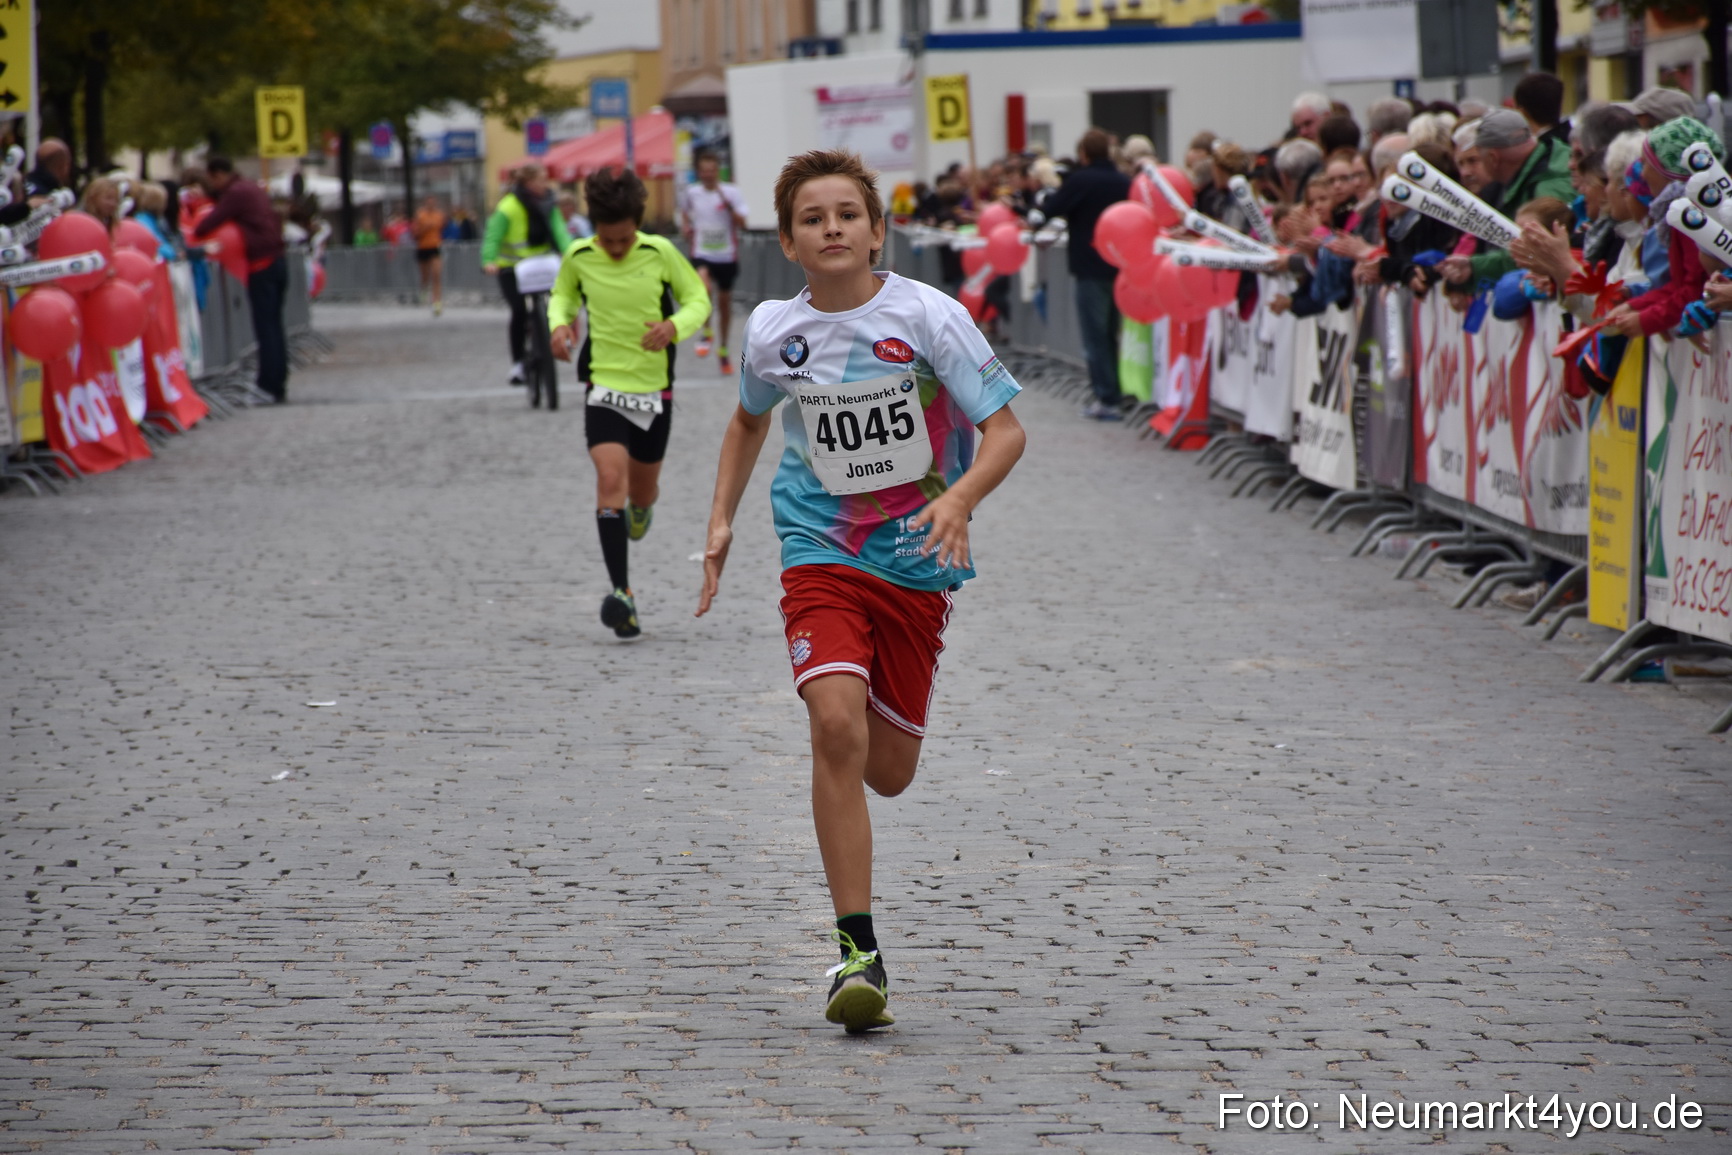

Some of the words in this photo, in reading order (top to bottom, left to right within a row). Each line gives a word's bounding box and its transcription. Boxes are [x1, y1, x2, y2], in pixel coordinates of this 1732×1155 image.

[270, 108, 295, 142] D
[939, 94, 962, 129] D
[799, 394, 826, 406] PARTL
[826, 386, 897, 406] Neumarkt
[816, 398, 915, 453] 4045
[845, 459, 895, 479] Jonas
